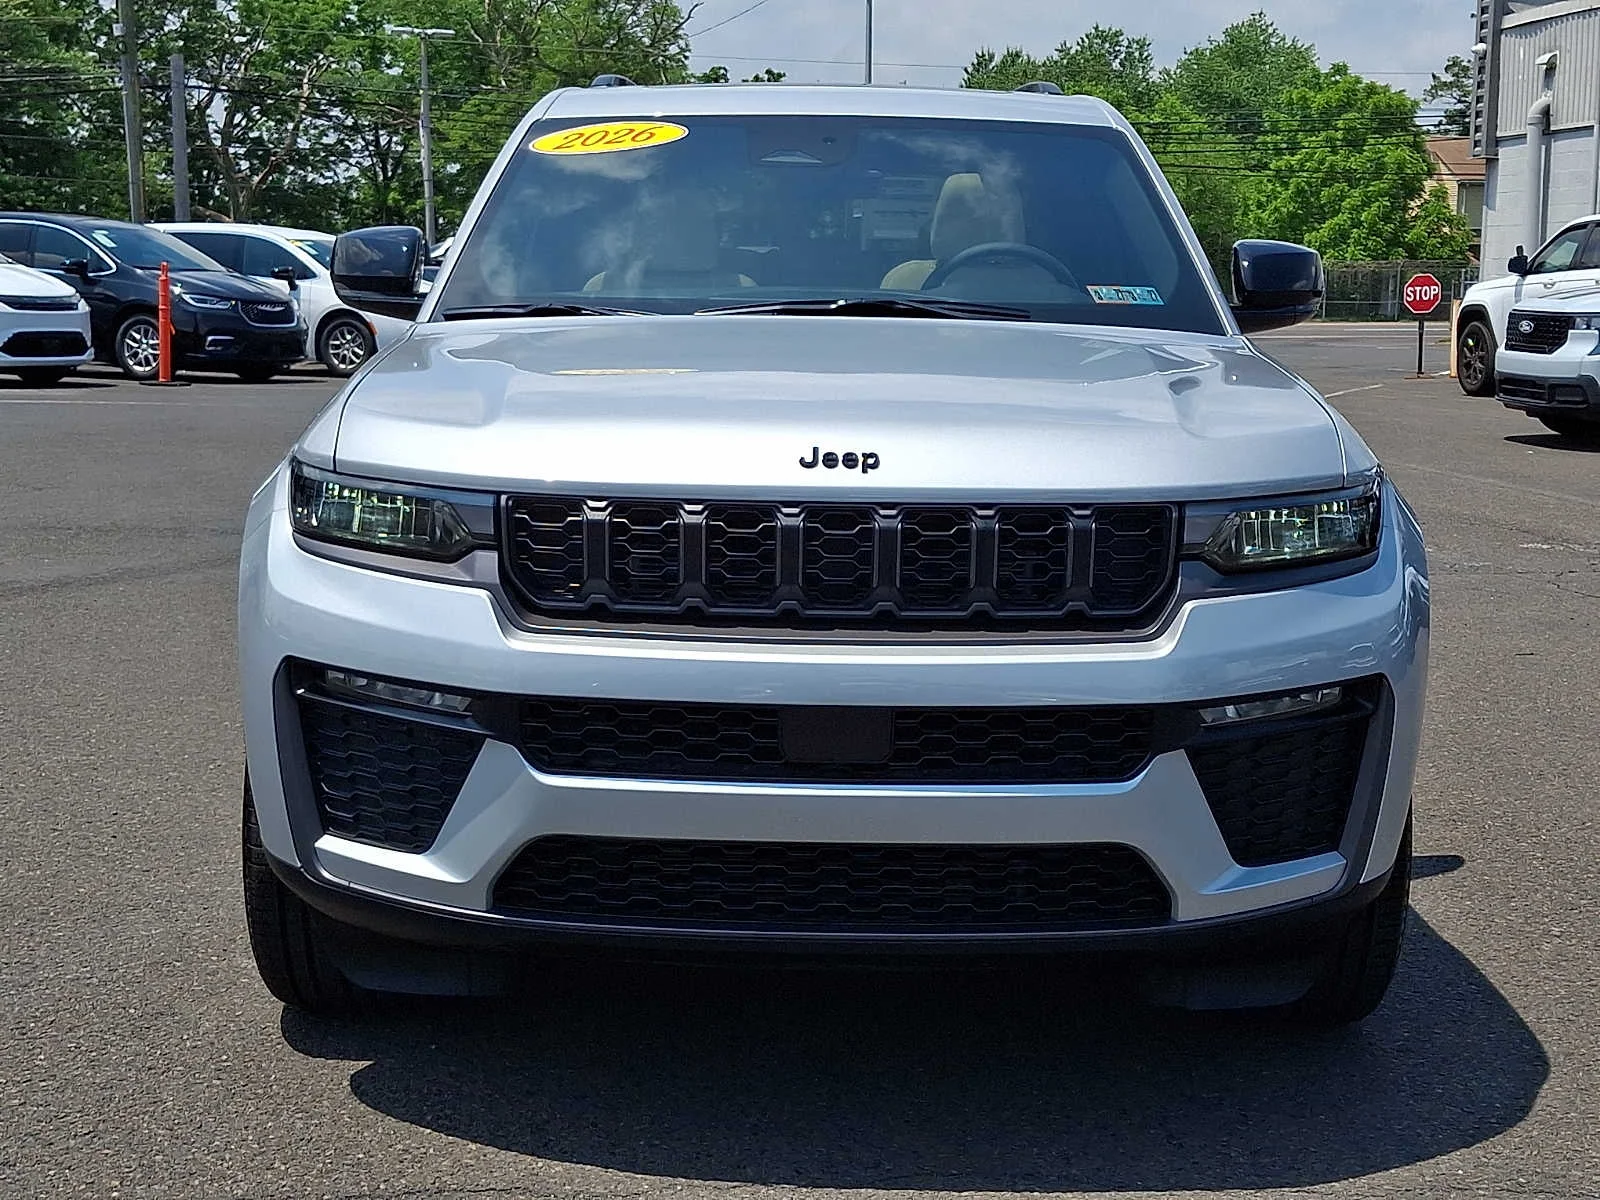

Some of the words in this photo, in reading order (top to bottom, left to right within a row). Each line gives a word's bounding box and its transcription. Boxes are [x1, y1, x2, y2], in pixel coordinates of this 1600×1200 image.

[552, 126, 663, 150] 2026
[1406, 285, 1439, 302] STOP
[799, 446, 881, 474] Jeep
